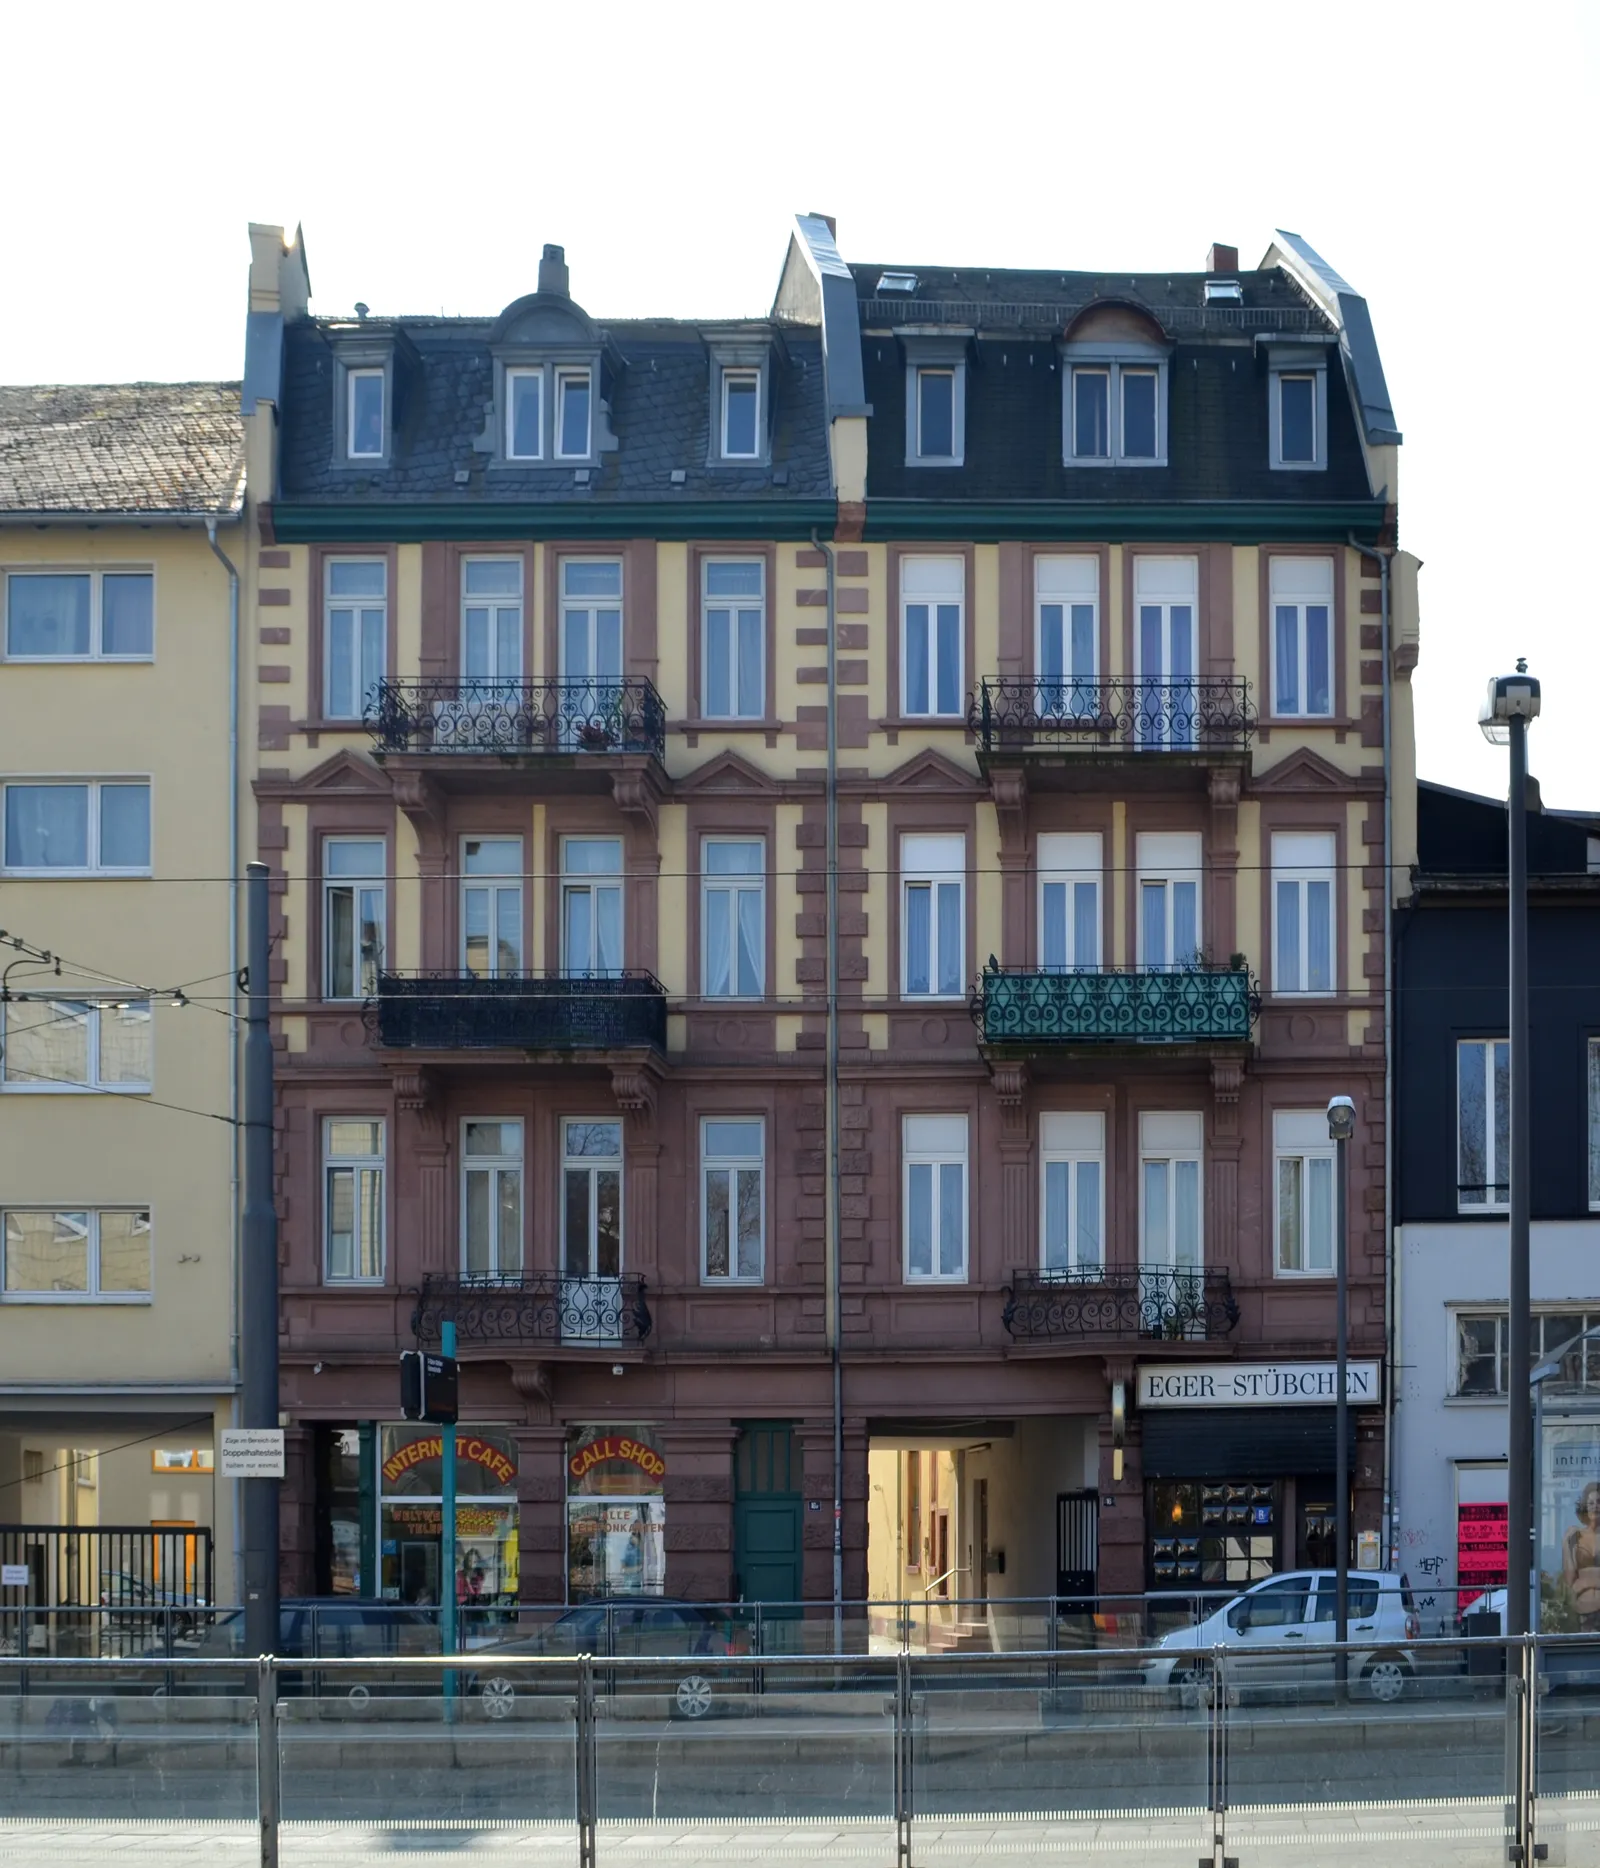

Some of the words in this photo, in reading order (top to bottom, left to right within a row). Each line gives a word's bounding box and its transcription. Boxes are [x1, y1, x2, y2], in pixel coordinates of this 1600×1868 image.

[222, 1449, 283, 1458] Doppelhaltestelle
[570, 1441, 615, 1476] CALL
[619, 1440, 665, 1476] SHOP
[383, 1439, 466, 1480] INTERNT
[468, 1442, 514, 1482] CAFE
[392, 1510, 442, 1521] WELTWE
[602, 1511, 630, 1520] ALLE
[571, 1523, 665, 1533] TELEFONKARTEN
